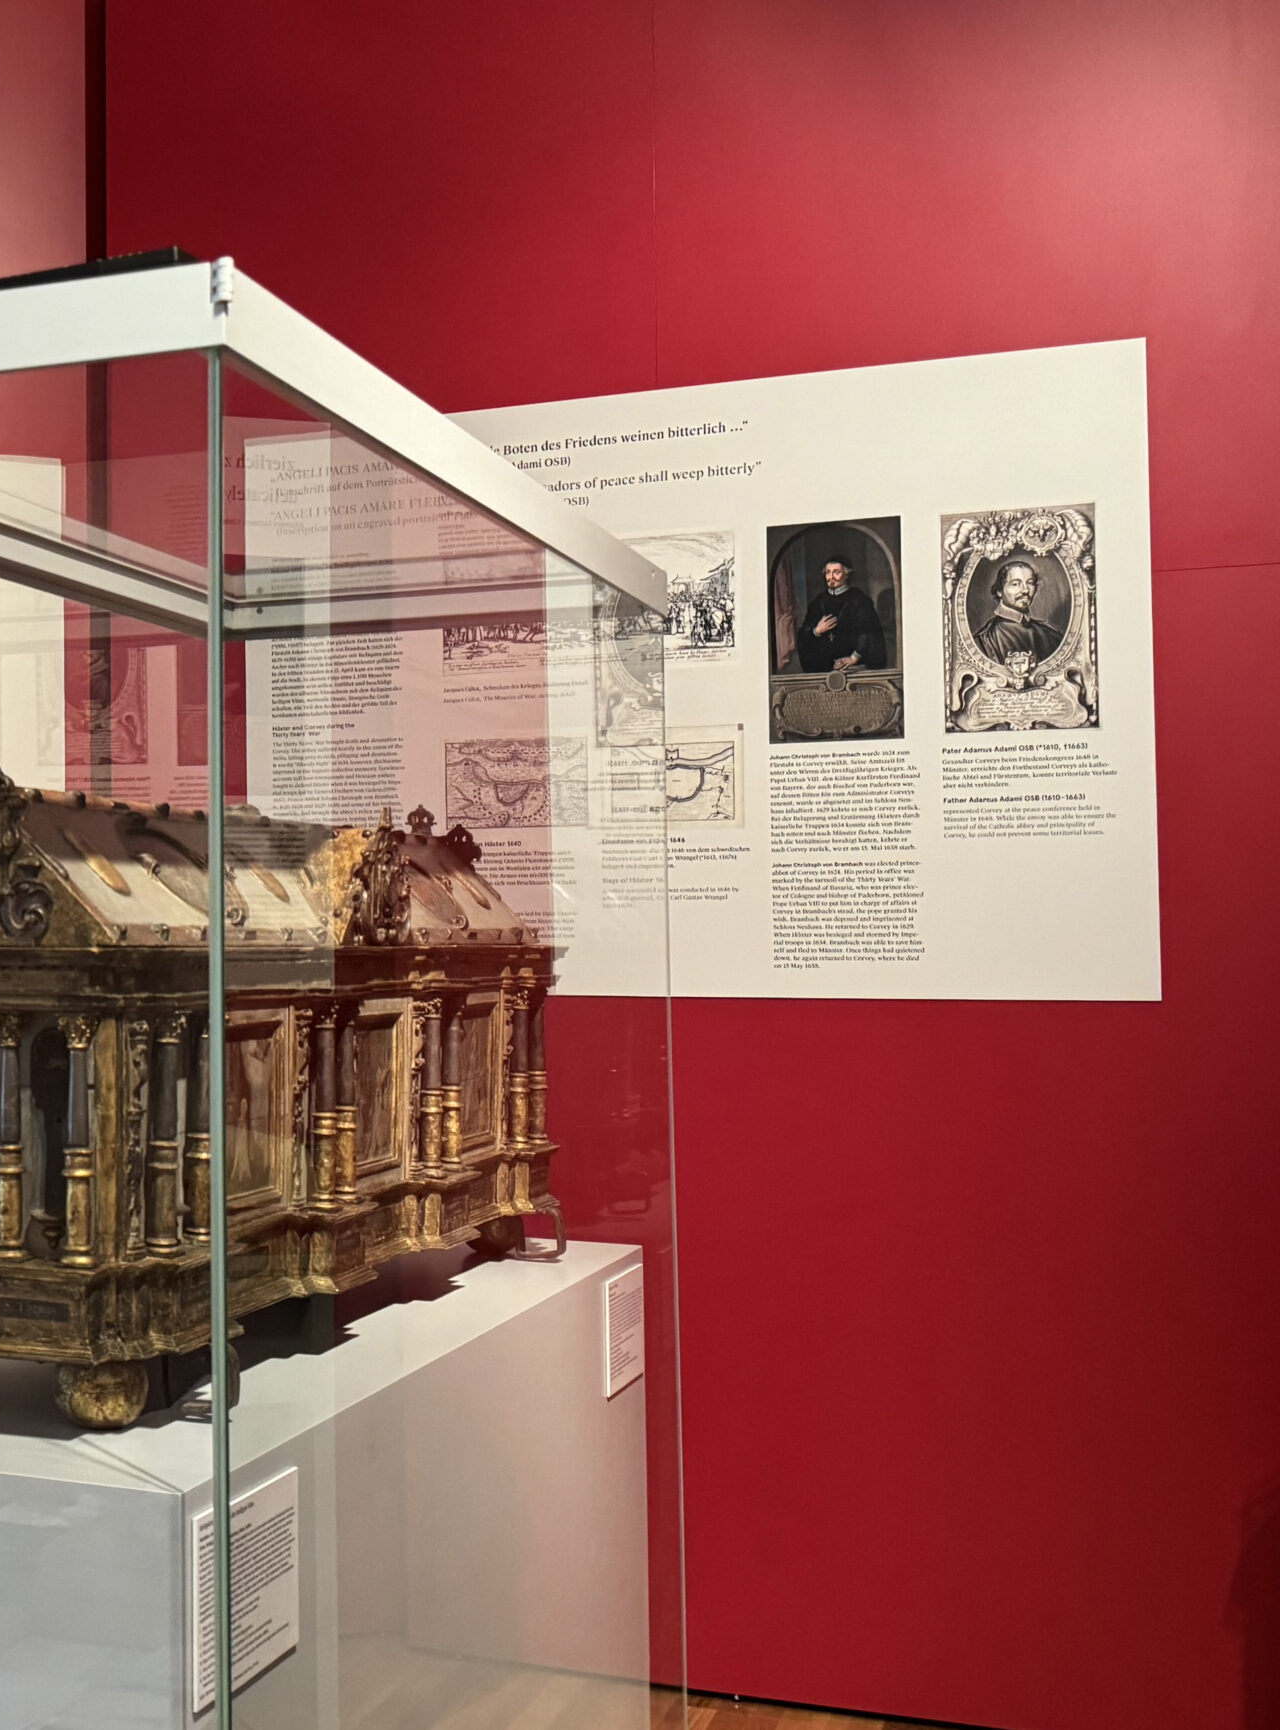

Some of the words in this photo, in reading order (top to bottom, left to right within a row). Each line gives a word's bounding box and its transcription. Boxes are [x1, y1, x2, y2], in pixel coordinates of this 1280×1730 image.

[503, 440, 538, 456] Boten
[540, 438, 561, 452] des
[564, 432, 617, 450] Friedens
[620, 427, 664, 444] weinen
[667, 421, 726, 439] bitterlich
[544, 455, 571, 470] OSB)
[583, 476, 596, 489] of
[599, 477, 635, 491] peace
[638, 469, 668, 484] shall
[671, 470, 704, 485] weep
[942, 747, 961, 755] Pater
[963, 746, 992, 754] Adamus
[994, 745, 1017, 753] Adami
[1018, 744, 1034, 752] OSB
[943, 796, 966, 804] Father
[968, 796, 997, 804] Adamus
[999, 795, 1022, 803] Adami
[1024, 794, 1039, 802] OSB
